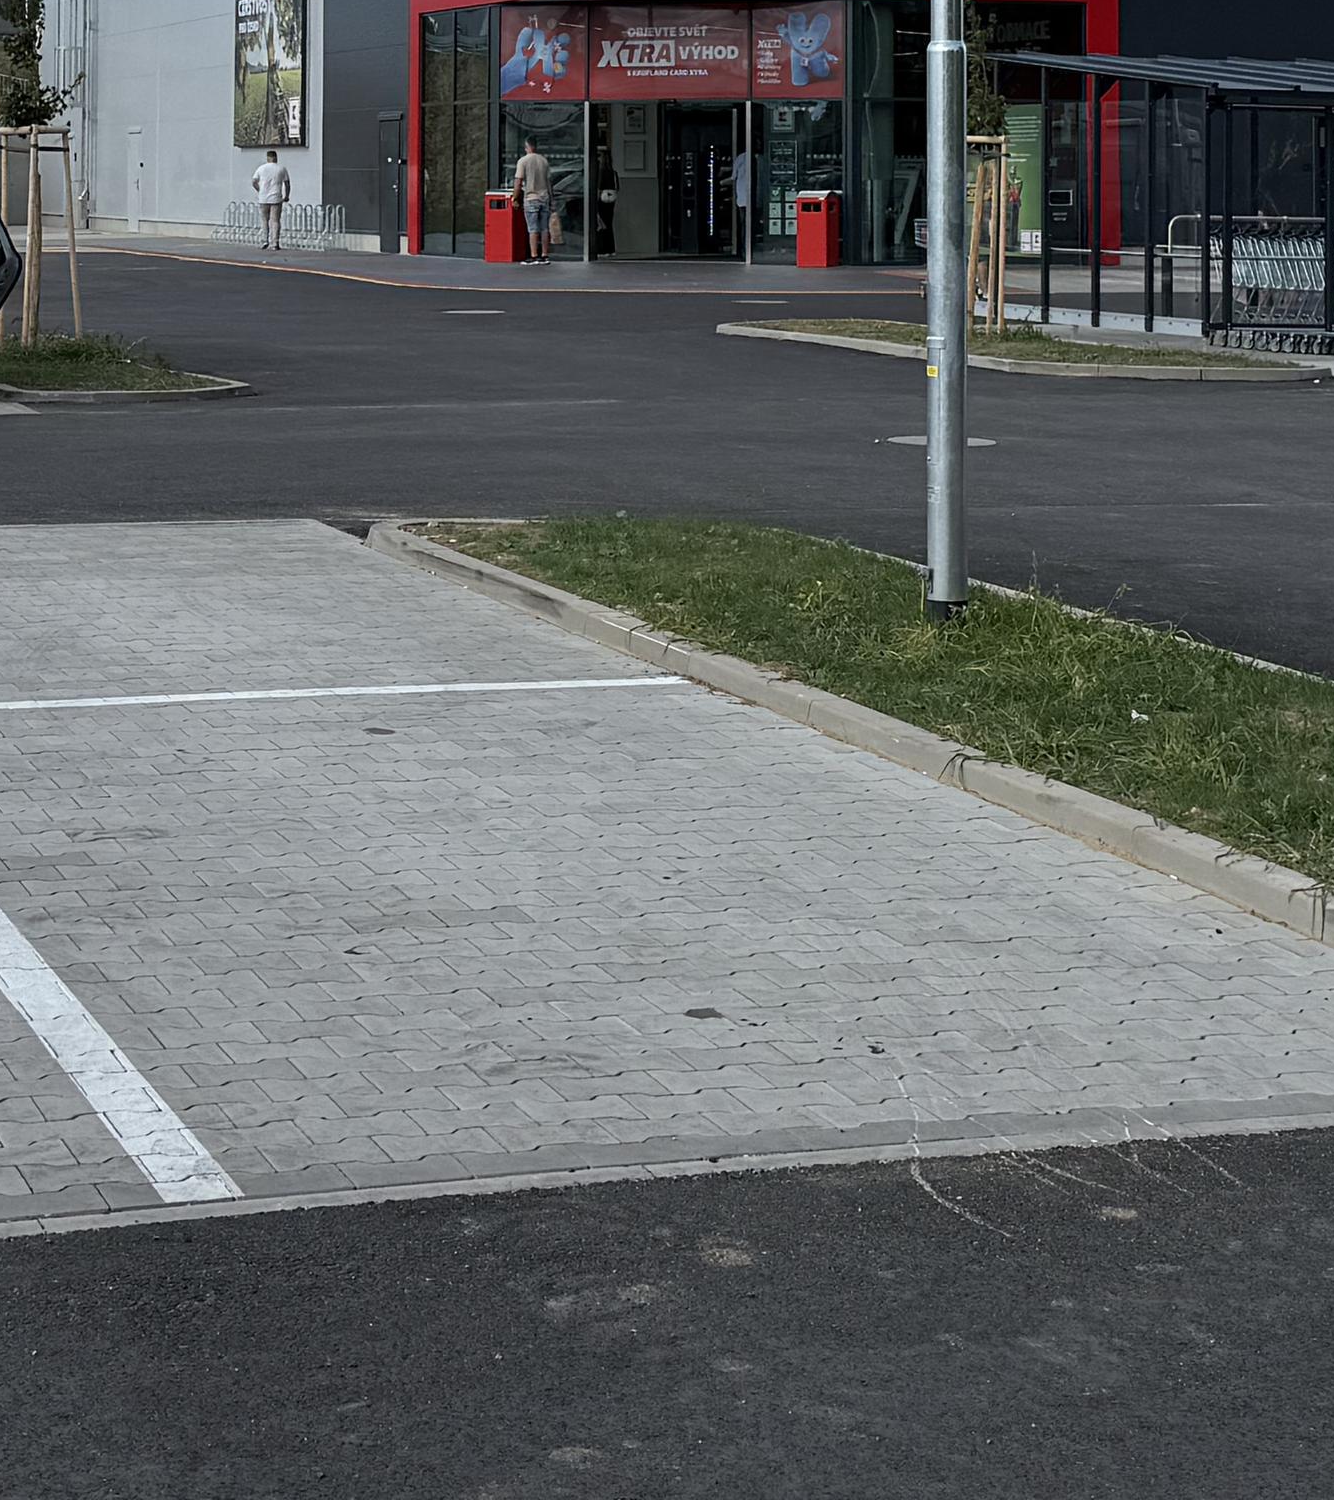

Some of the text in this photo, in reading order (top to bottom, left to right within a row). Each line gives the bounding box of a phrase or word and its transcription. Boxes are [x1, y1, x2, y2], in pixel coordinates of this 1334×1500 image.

[627, 26, 677, 38] OBJEVTE
[597, 40, 739, 68] XTRA VÝHOD
